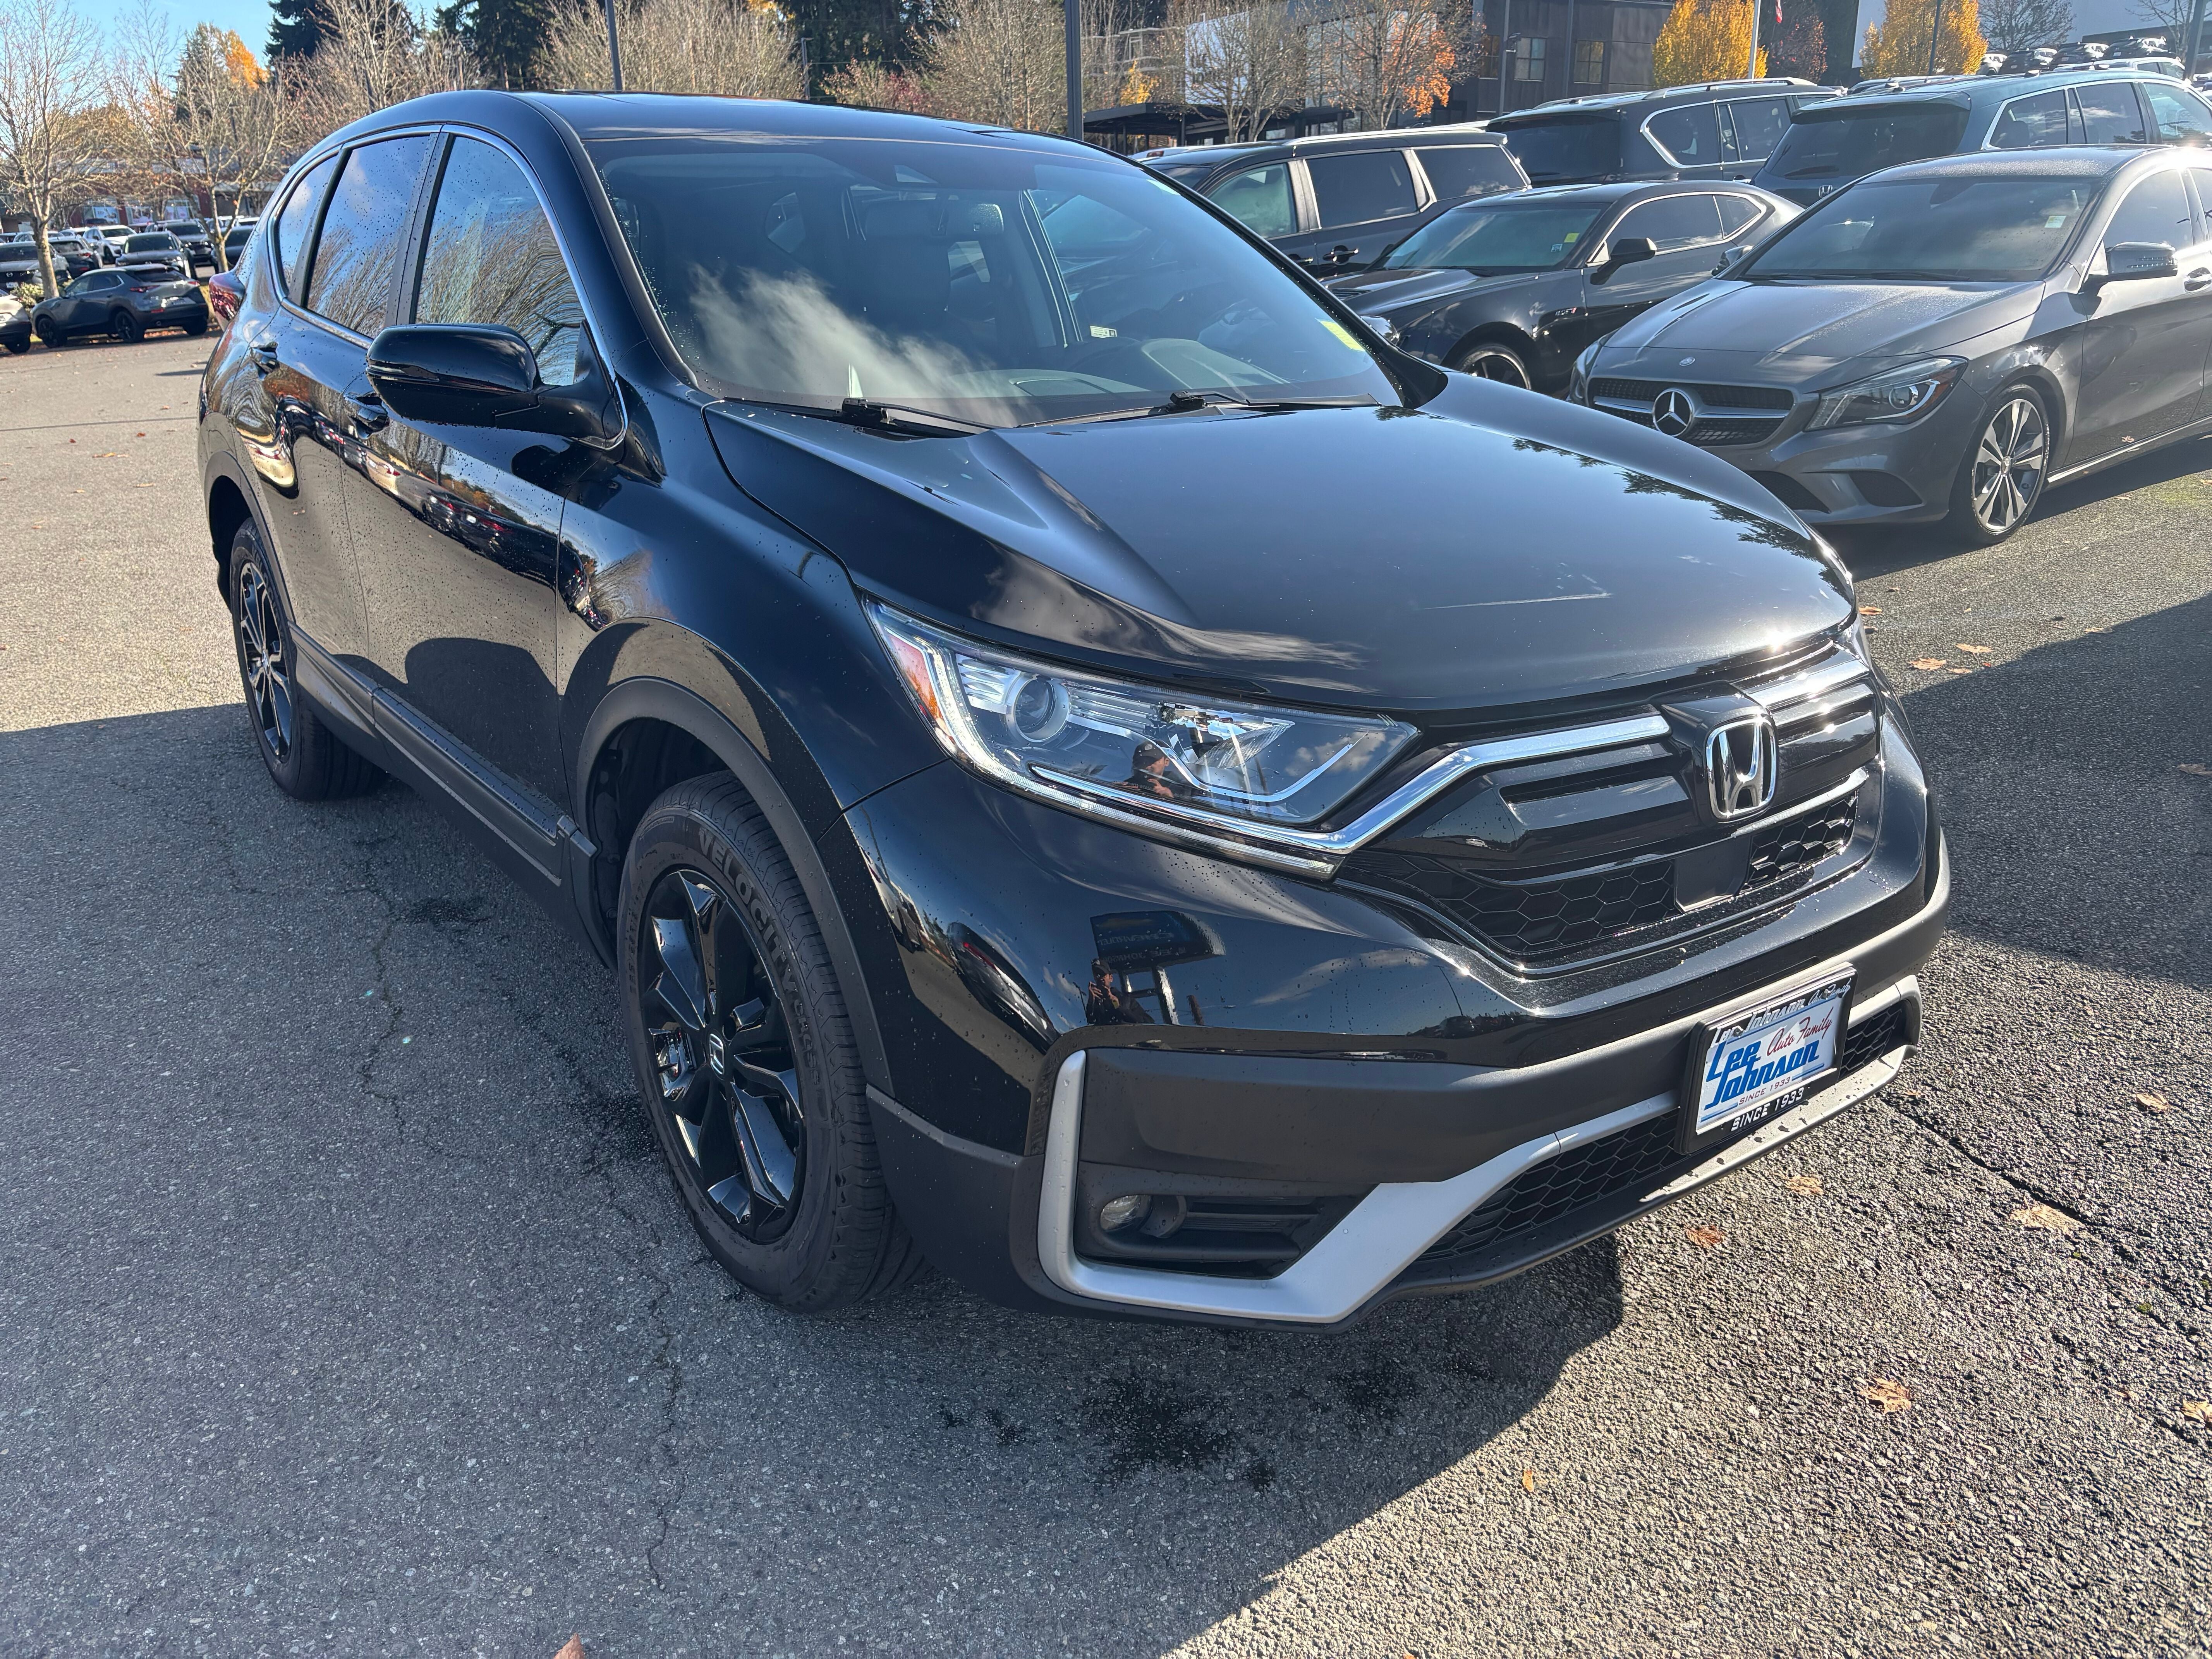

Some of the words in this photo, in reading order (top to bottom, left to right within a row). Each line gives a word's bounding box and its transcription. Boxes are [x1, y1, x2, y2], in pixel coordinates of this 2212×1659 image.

[699, 827, 799, 993] VELOCITY
[1743, 999, 1805, 1033] Johnson
[1767, 1028, 1795, 1056] Auto
[1796, 1006, 1834, 1044] Family
[1704, 1040, 1819, 1110] Johnson
[1706, 1041, 1761, 1082] Lee
[1731, 1103, 1771, 1132] SINCE
[1775, 1087, 1804, 1111] 1933
[1739, 1087, 1766, 1105] SINCE
[1770, 1077, 1791, 1091] 1933
